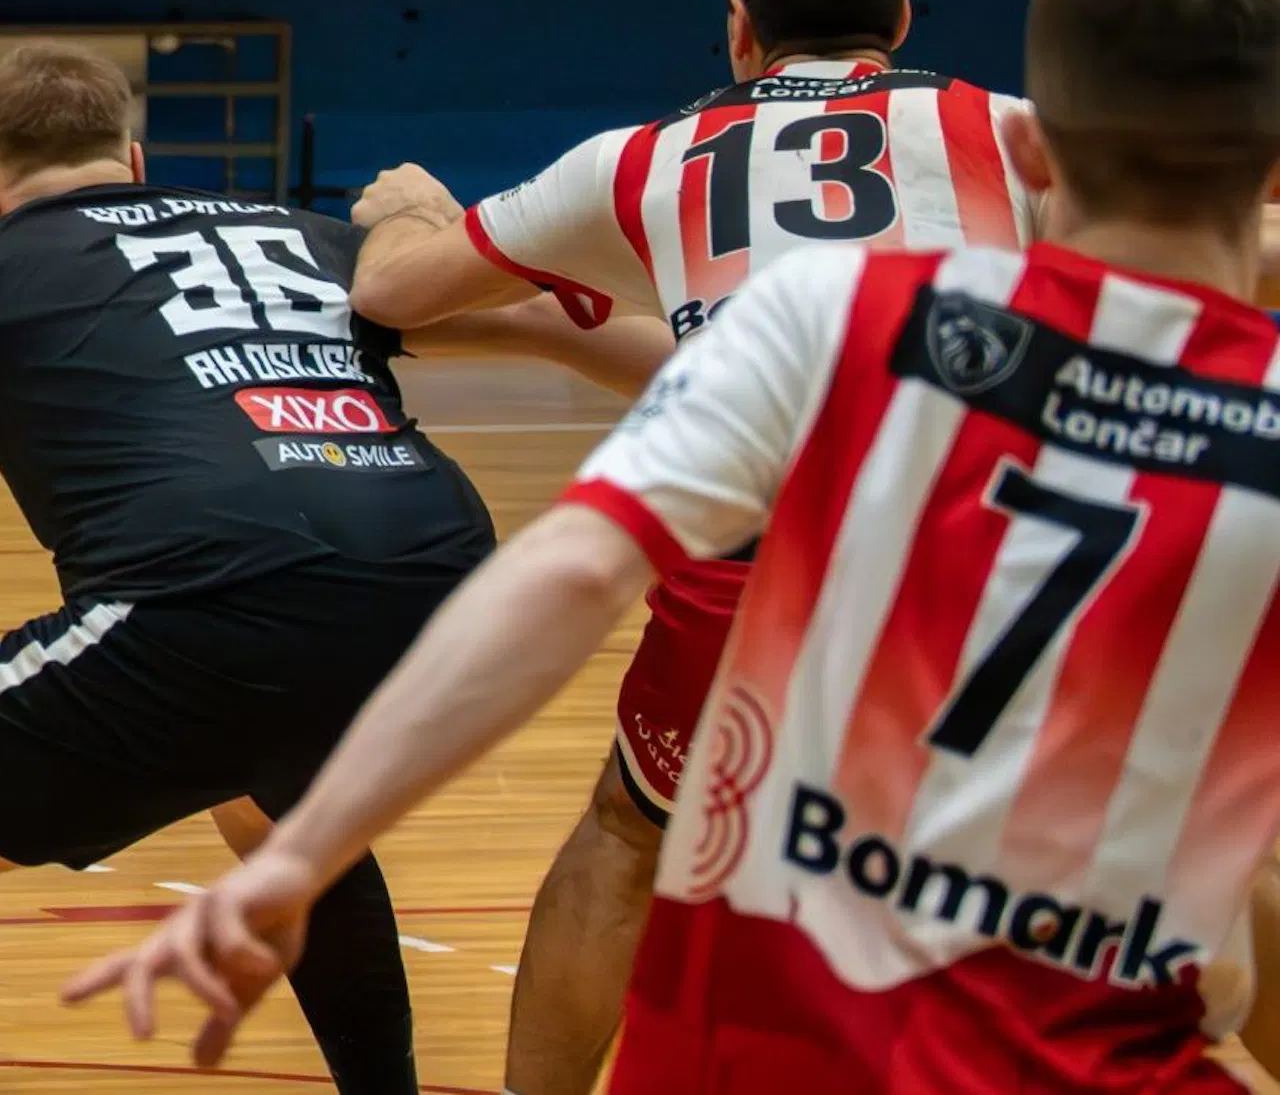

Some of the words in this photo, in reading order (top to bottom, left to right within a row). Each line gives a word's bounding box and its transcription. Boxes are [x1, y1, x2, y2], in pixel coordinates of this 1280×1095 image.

[681, 110, 898, 261] 13
[115, 224, 354, 341] 36
[250, 394, 380, 433] XIXO
[345, 444, 416, 467] SMILE
[1054, 354, 1280, 441] Automob
[985, 455, 1148, 761] 7
[780, 780, 1212, 994] Bomark
